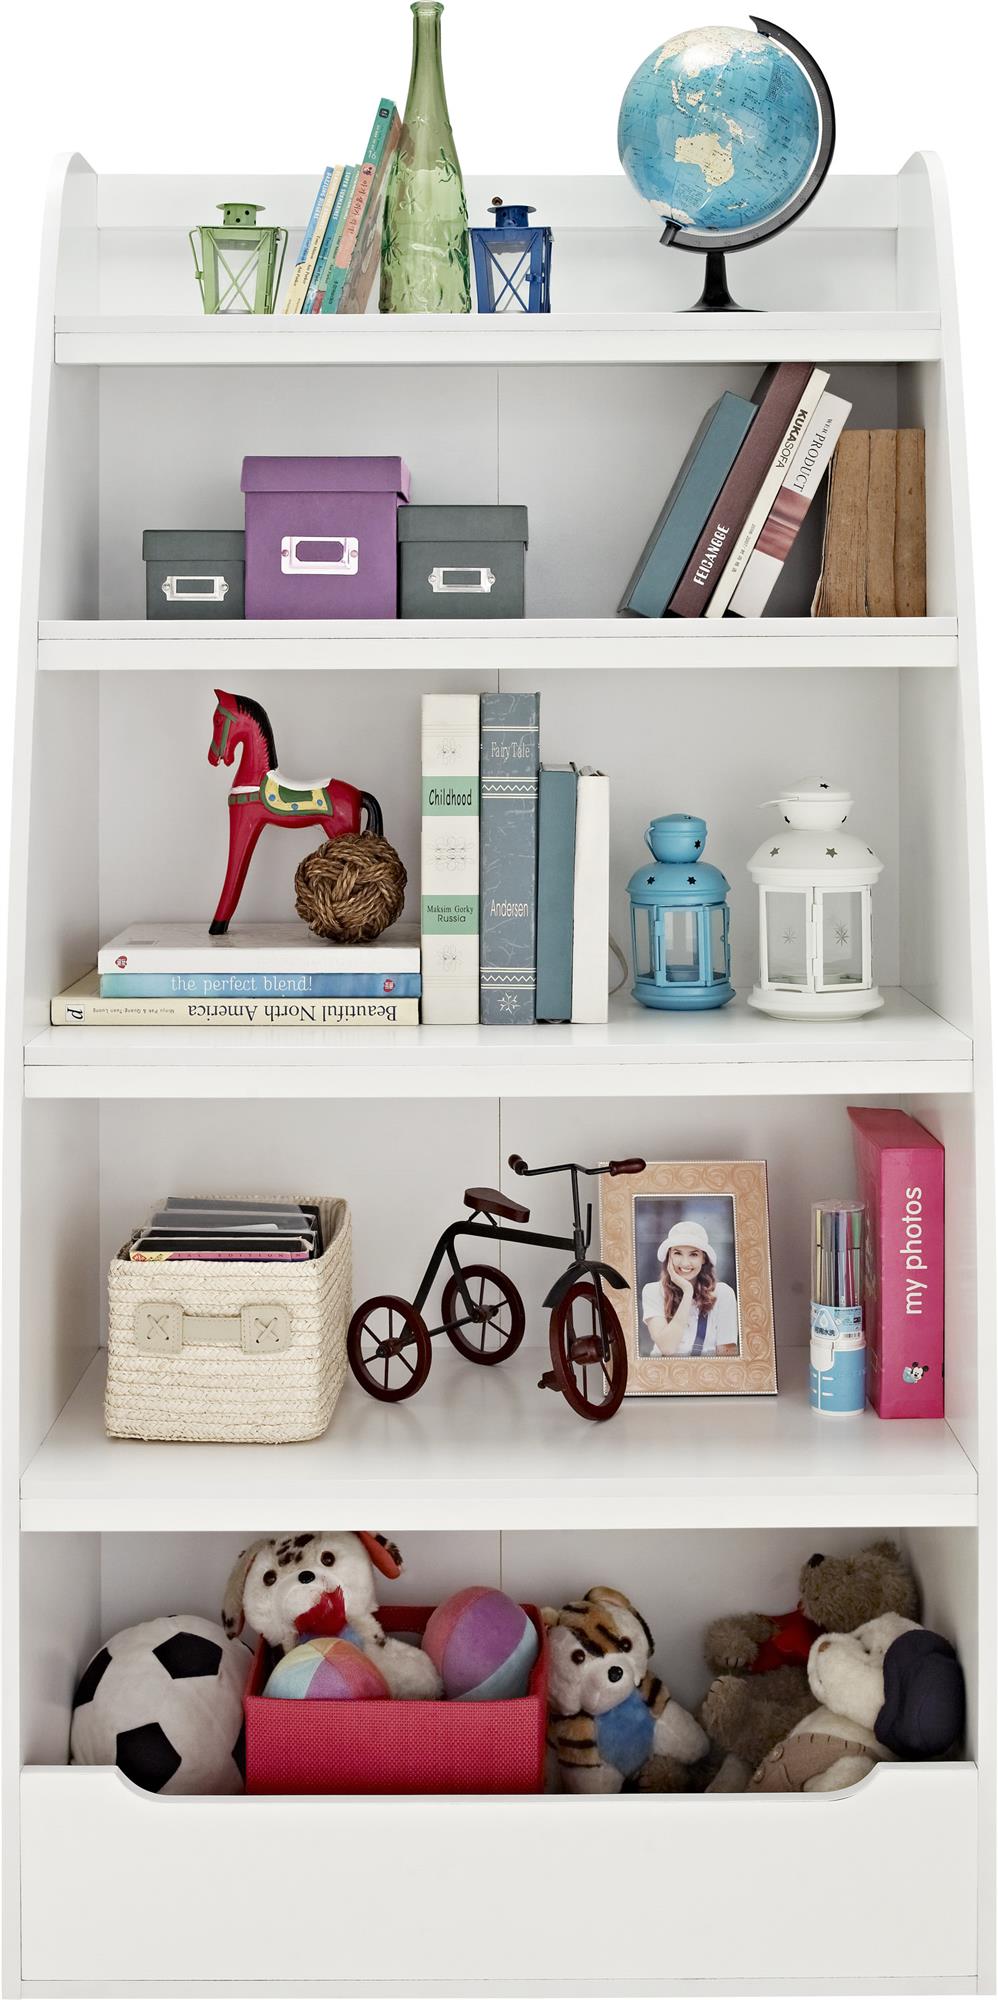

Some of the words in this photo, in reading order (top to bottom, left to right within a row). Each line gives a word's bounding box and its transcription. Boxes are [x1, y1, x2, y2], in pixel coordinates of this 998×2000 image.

[775, 409, 808, 469] KUKASOFA
[793, 432, 827, 493] PRODUCT
[491, 741, 511, 761] Fairy
[511, 741, 531, 759] Tale
[428, 789, 473, 807] Childhood
[427, 905, 452, 914] Maksim
[454, 905, 474, 915] Gorky
[490, 899, 529, 917] Andersen
[437, 914, 467, 923] Russia
[171, 976, 196, 992] the
[204, 976, 257, 995] perfect
[264, 975, 312, 992] blend!
[188, 1005, 258, 1021] America
[265, 1005, 318, 1021] North
[323, 1005, 397, 1021] Beautiful
[899, 1186, 927, 1270] photos
[906, 1278, 927, 1315] my
